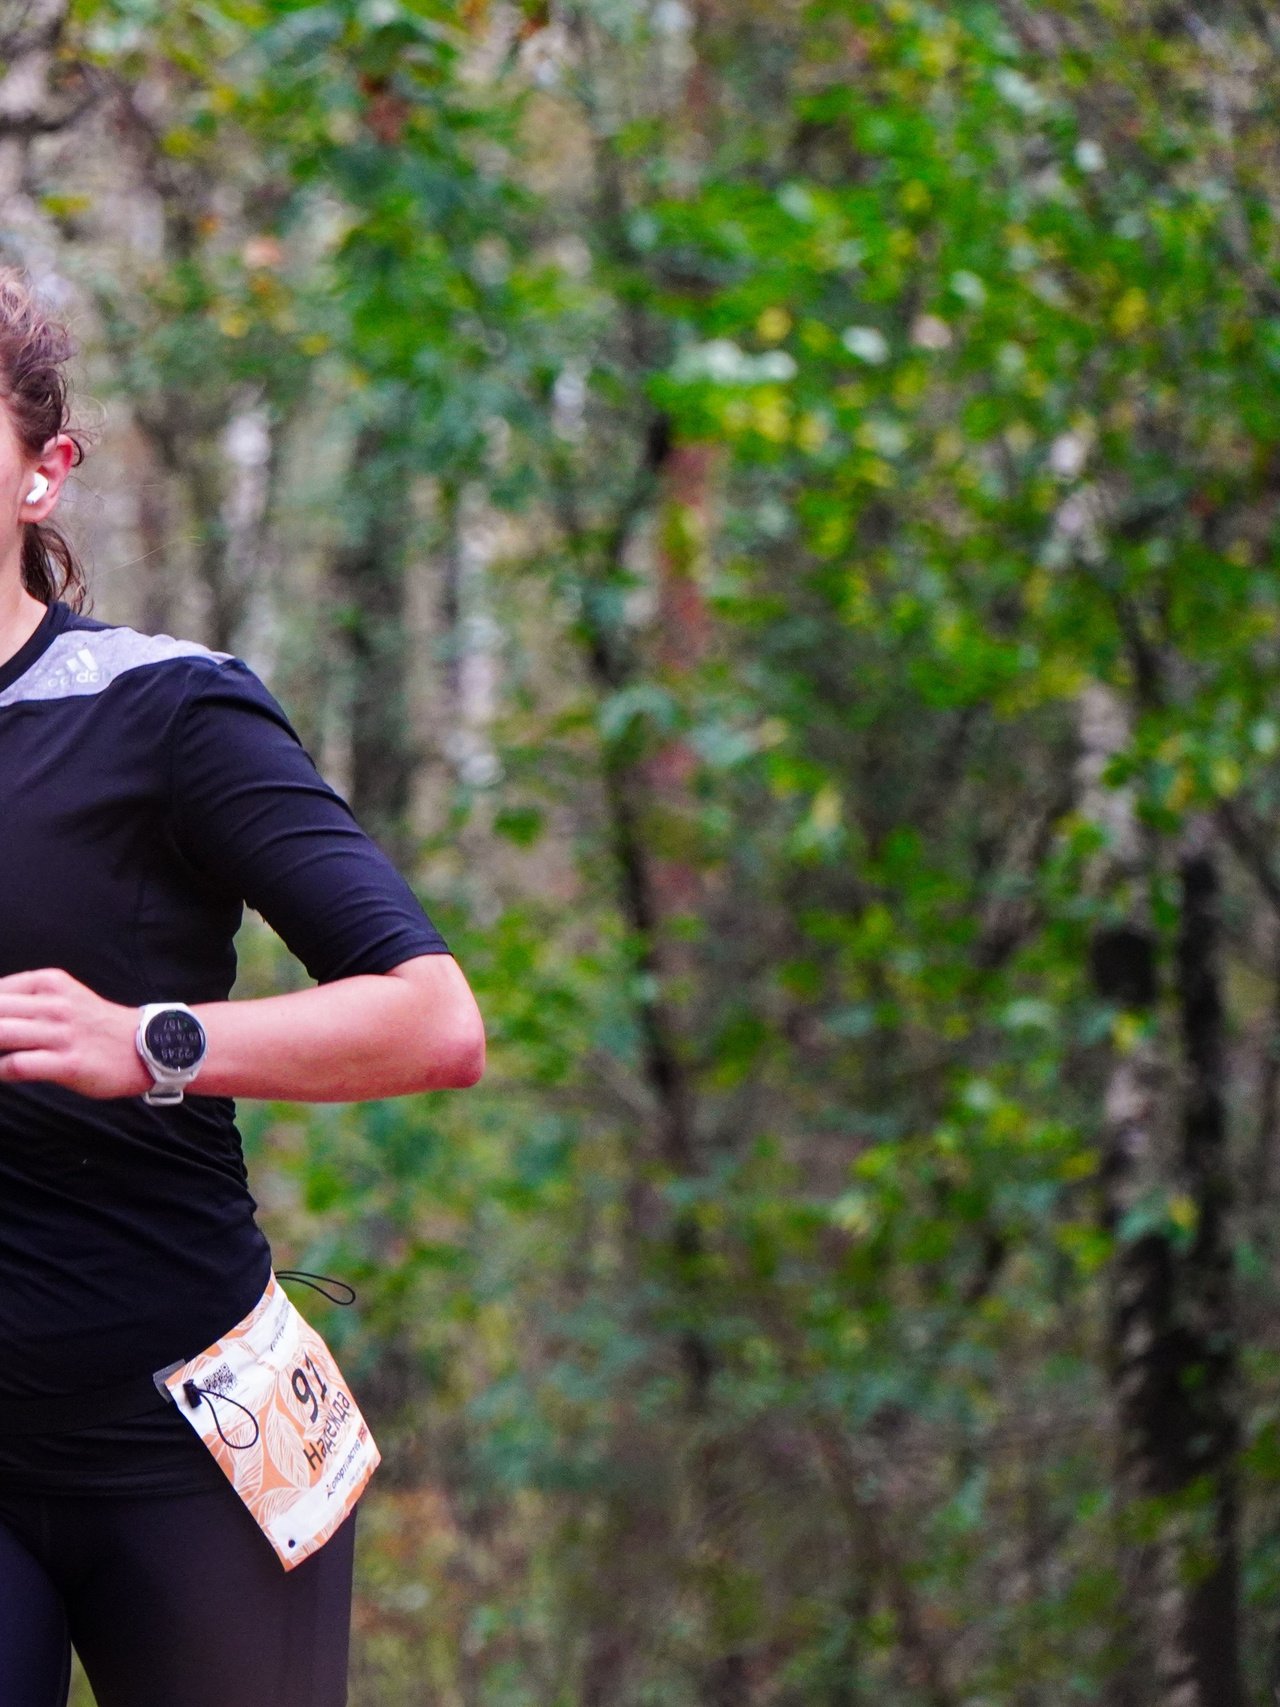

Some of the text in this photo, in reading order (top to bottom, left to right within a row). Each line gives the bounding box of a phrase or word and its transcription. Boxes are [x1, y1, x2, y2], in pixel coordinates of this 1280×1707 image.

[291, 1352, 328, 1424] 91
[303, 1391, 351, 1471] Надежда
[330, 1438, 362, 1490] спортастер
